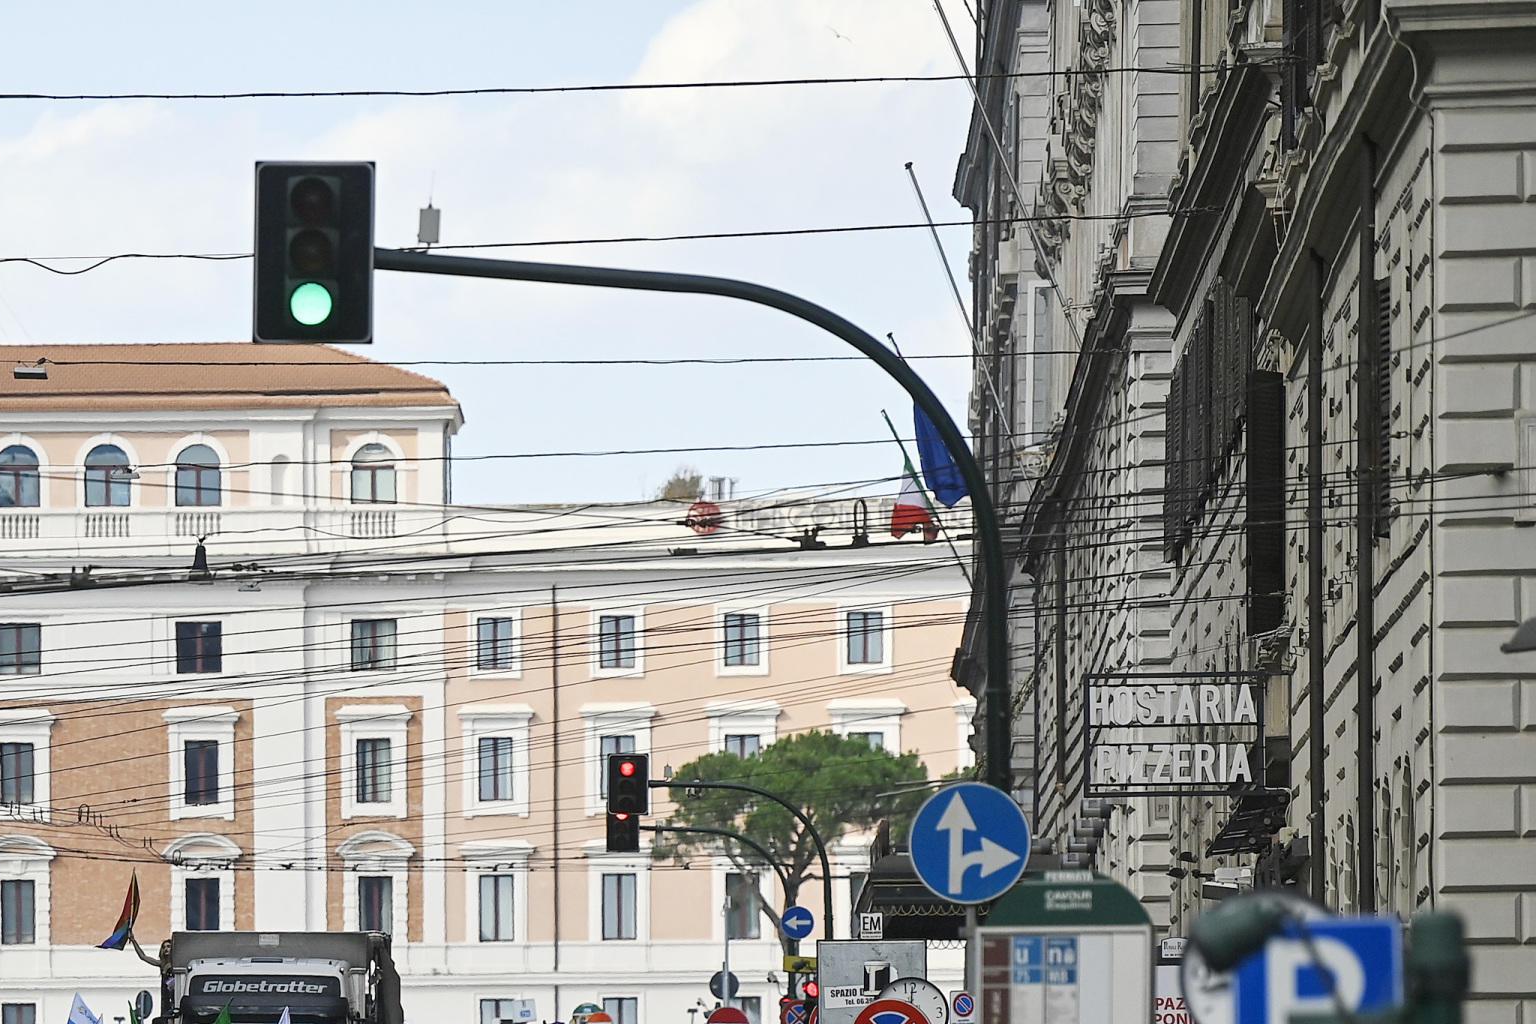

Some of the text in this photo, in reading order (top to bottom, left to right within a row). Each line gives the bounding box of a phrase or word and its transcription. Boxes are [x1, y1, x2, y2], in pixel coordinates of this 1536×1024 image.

[1089, 684, 1257, 726] HOSTARIA
[1096, 743, 1252, 784] PIZZERIA
[203, 980, 327, 994] Globetrotter
[830, 988, 857, 998] SPAZIO
